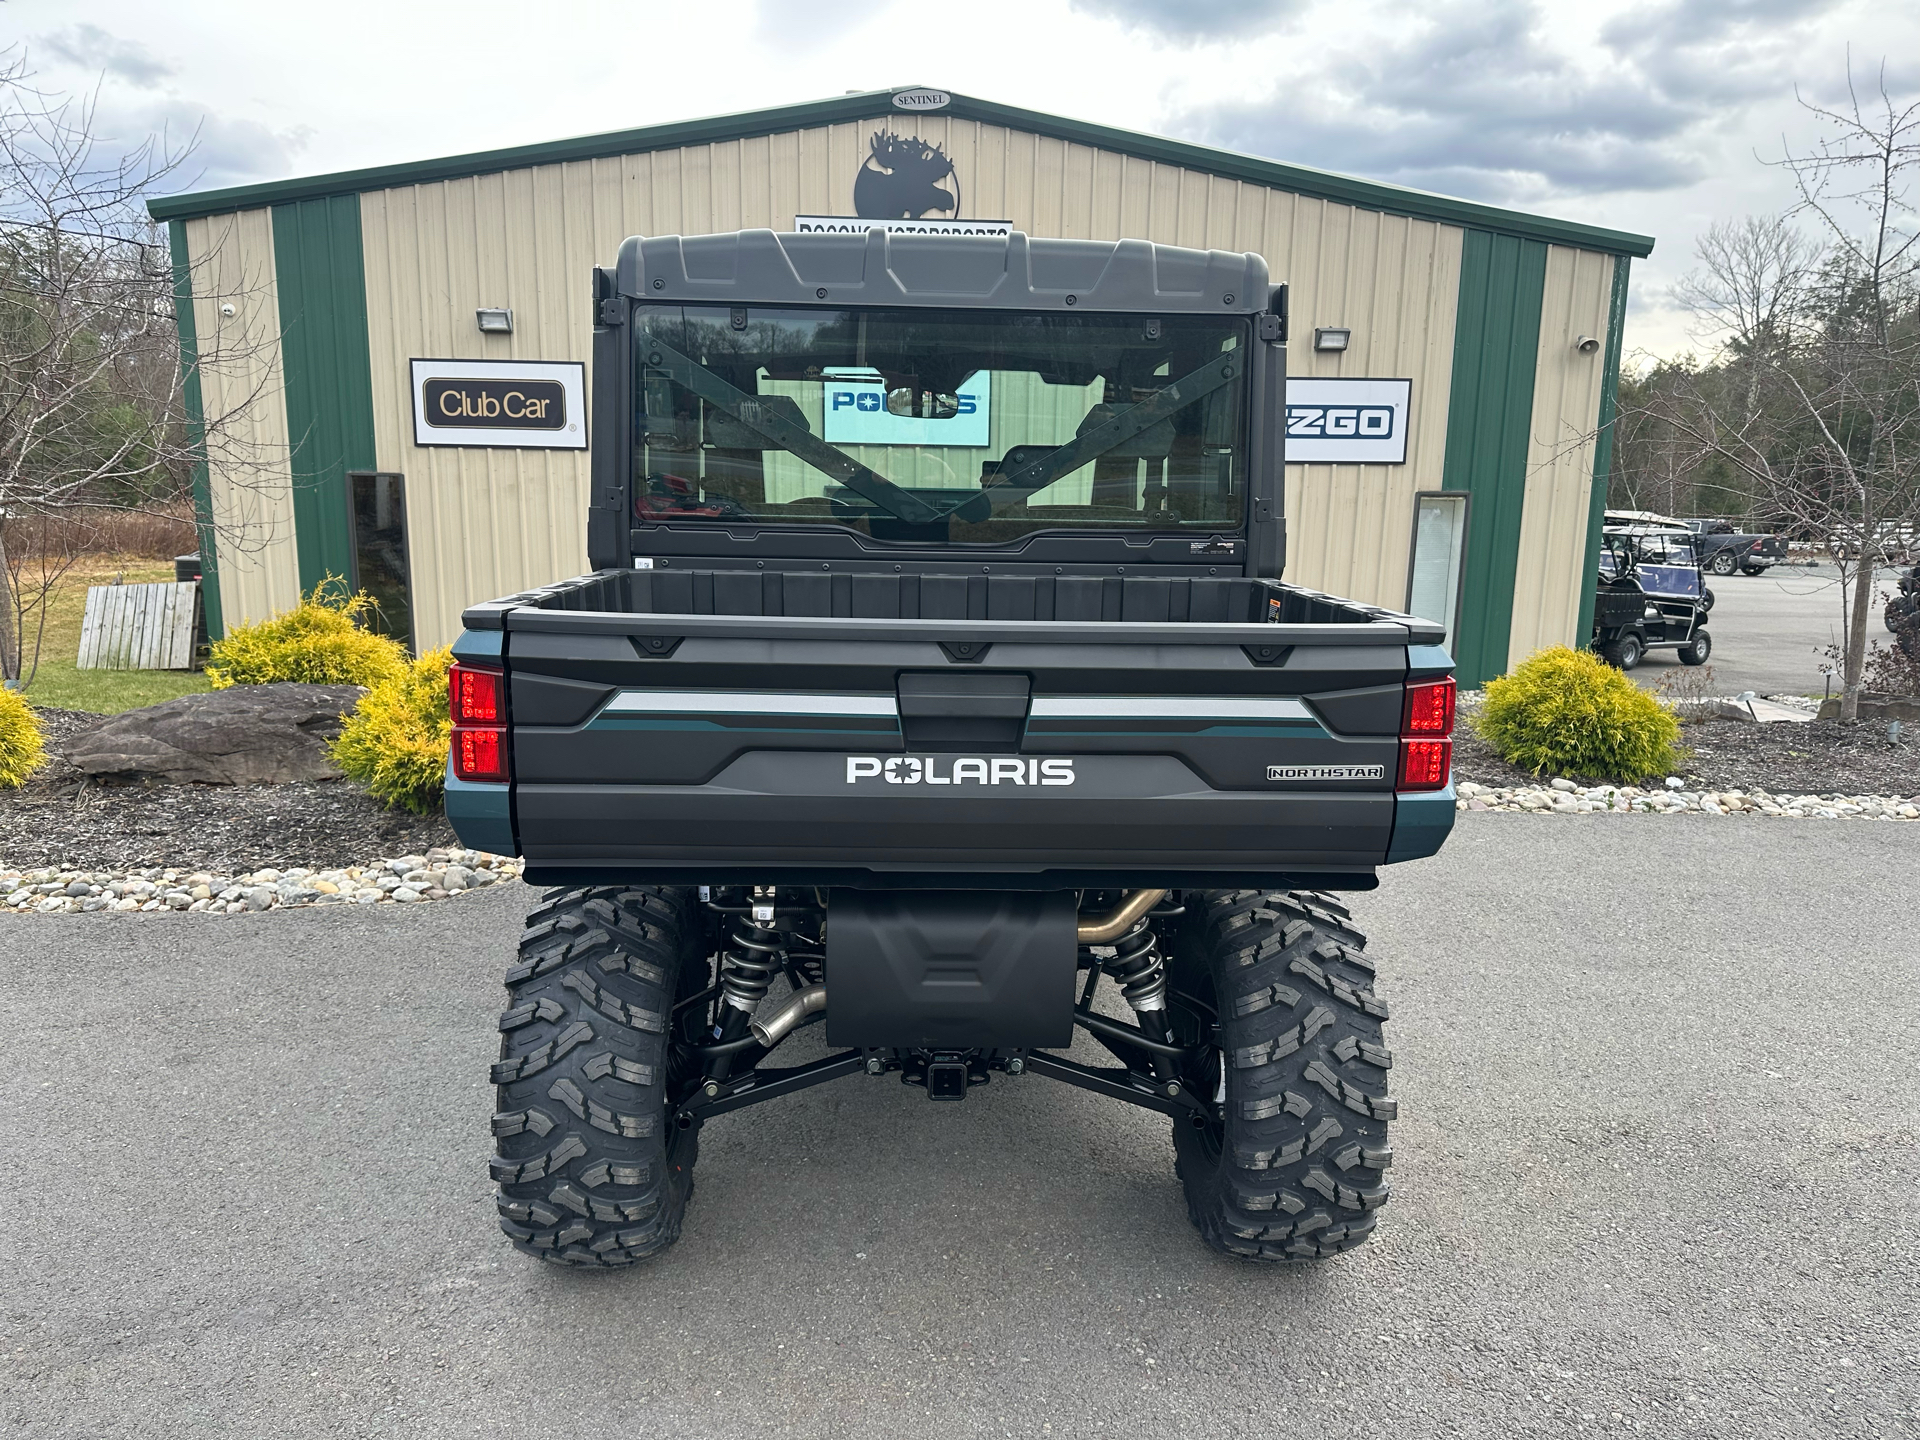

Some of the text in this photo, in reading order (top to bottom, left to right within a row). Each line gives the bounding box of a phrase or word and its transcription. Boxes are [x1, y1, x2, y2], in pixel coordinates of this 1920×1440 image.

[898, 94, 945, 105] SENTINEL
[439, 390, 550, 418] Club Car
[1285, 408, 1391, 436] ZGO
[846, 757, 1076, 786] POLARIS
[1272, 768, 1379, 778] NORTHSTAR
